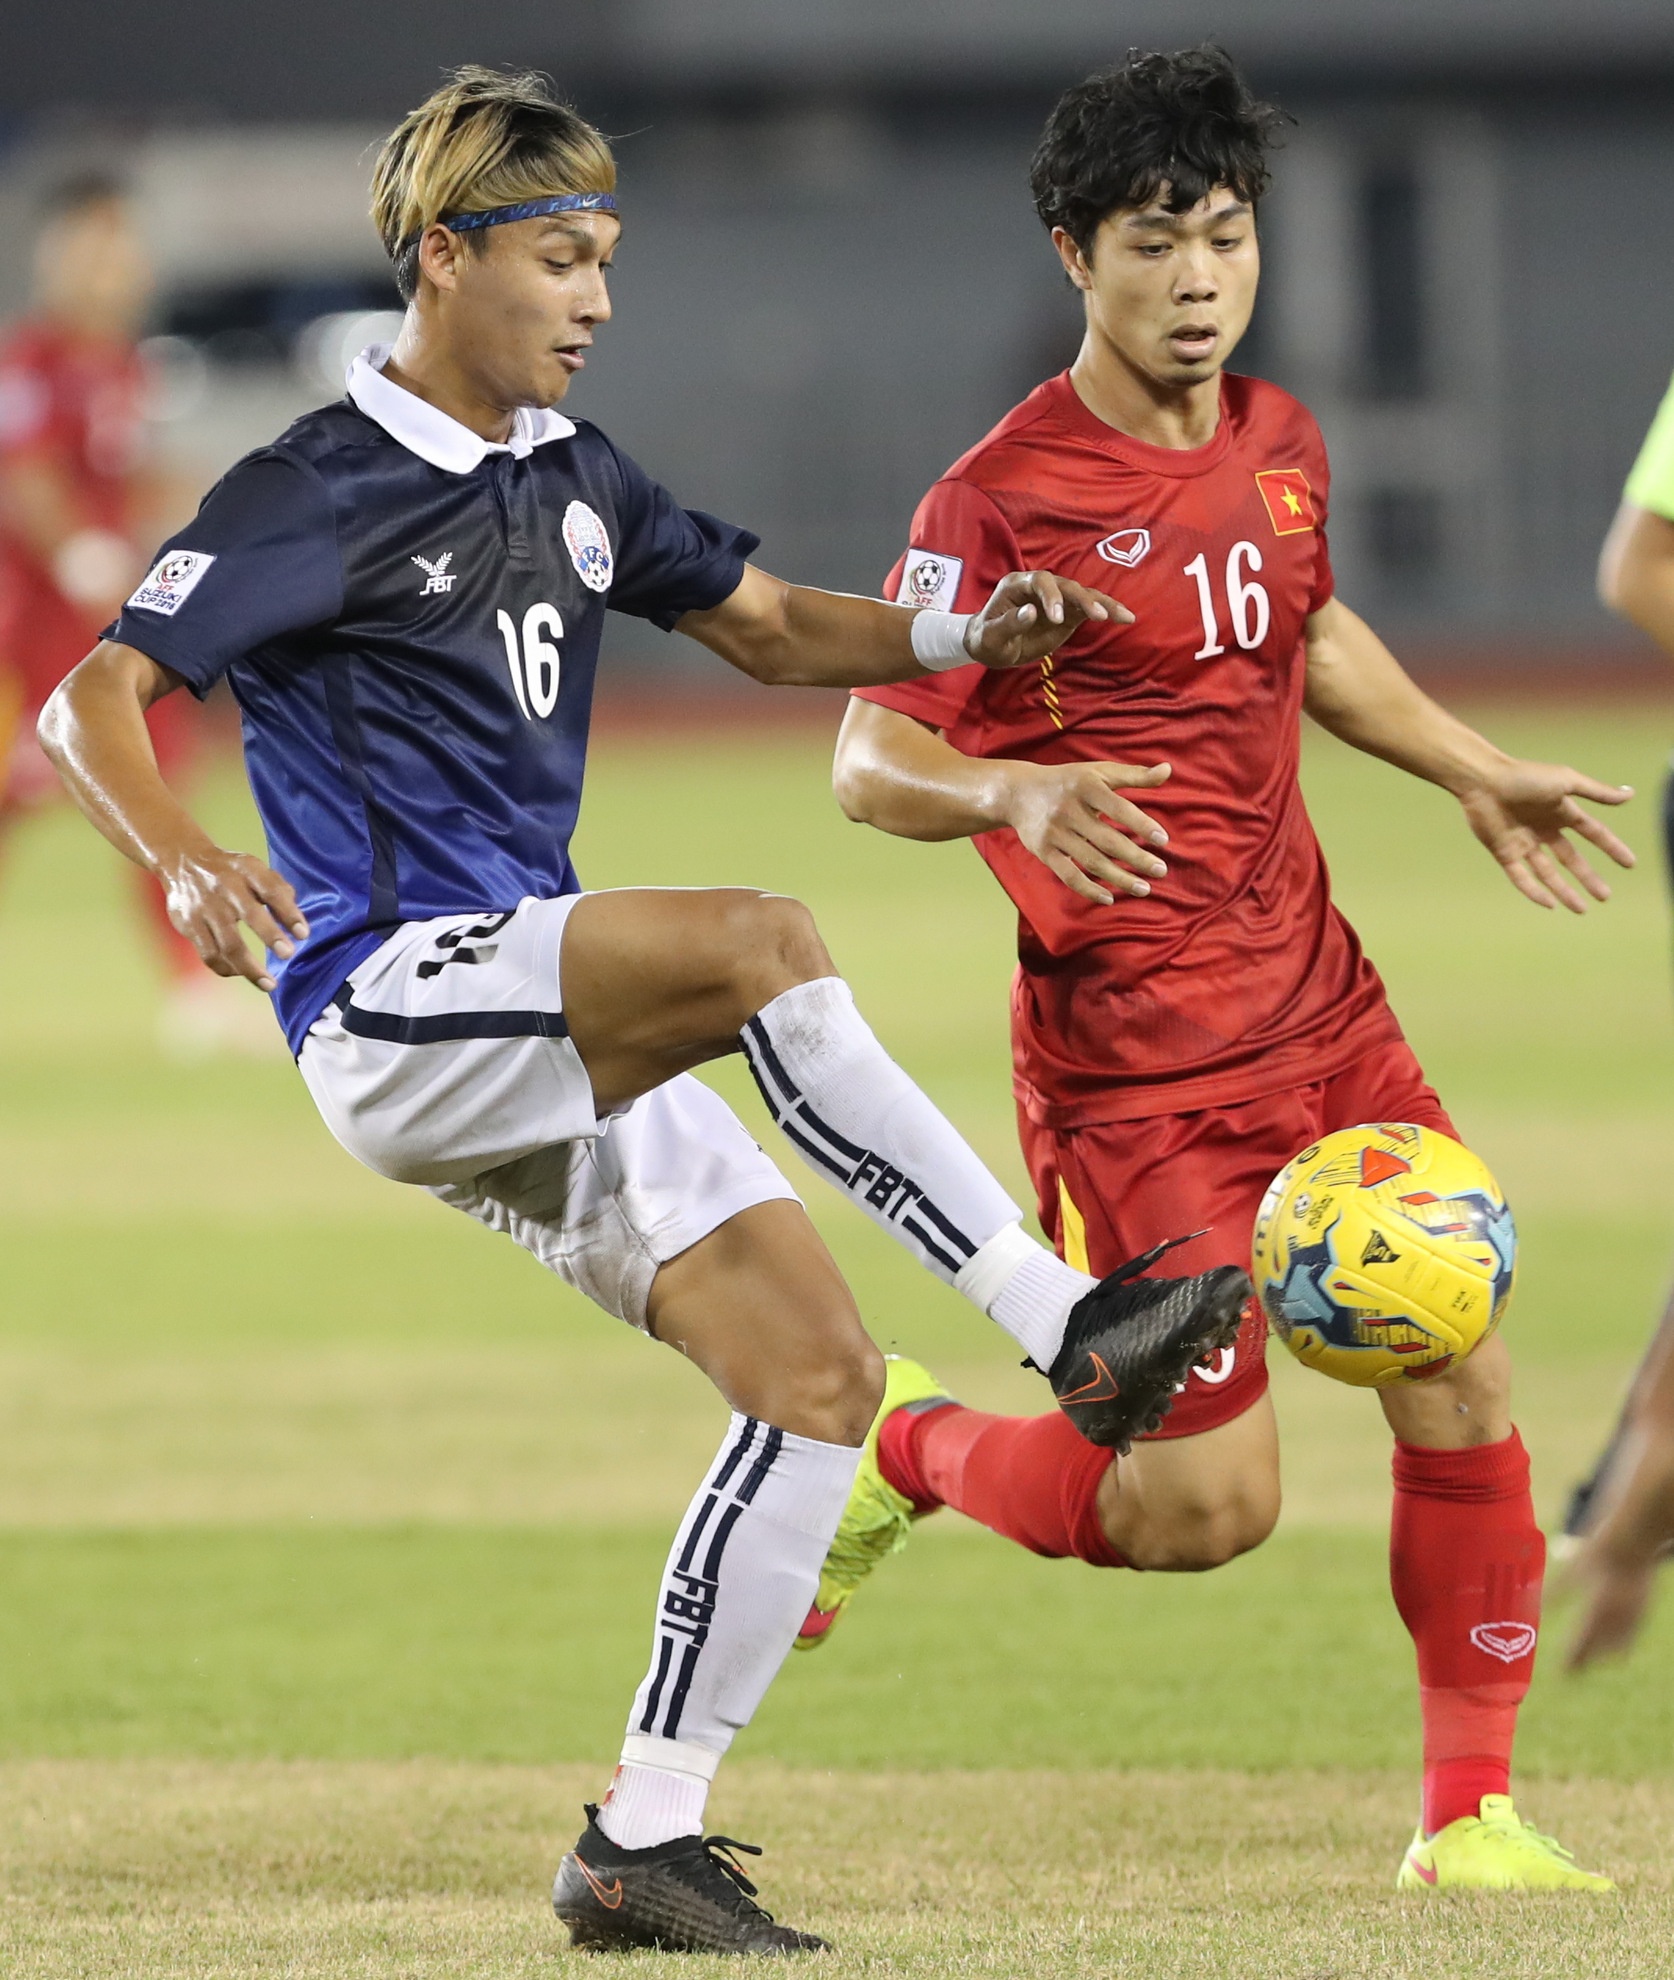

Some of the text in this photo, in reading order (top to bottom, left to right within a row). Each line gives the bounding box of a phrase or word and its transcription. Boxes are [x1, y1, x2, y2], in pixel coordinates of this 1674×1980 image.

[134, 594, 176, 610] CUP 2016
[140, 587, 182, 602] SUZUKI
[419, 575, 457, 595] FBT
[914, 597, 933, 606] AFF
[1183, 540, 1270, 661] 16
[497, 602, 564, 720] 16
[847, 1150, 925, 1221] FBT
[661, 1569, 719, 1649] FBT
